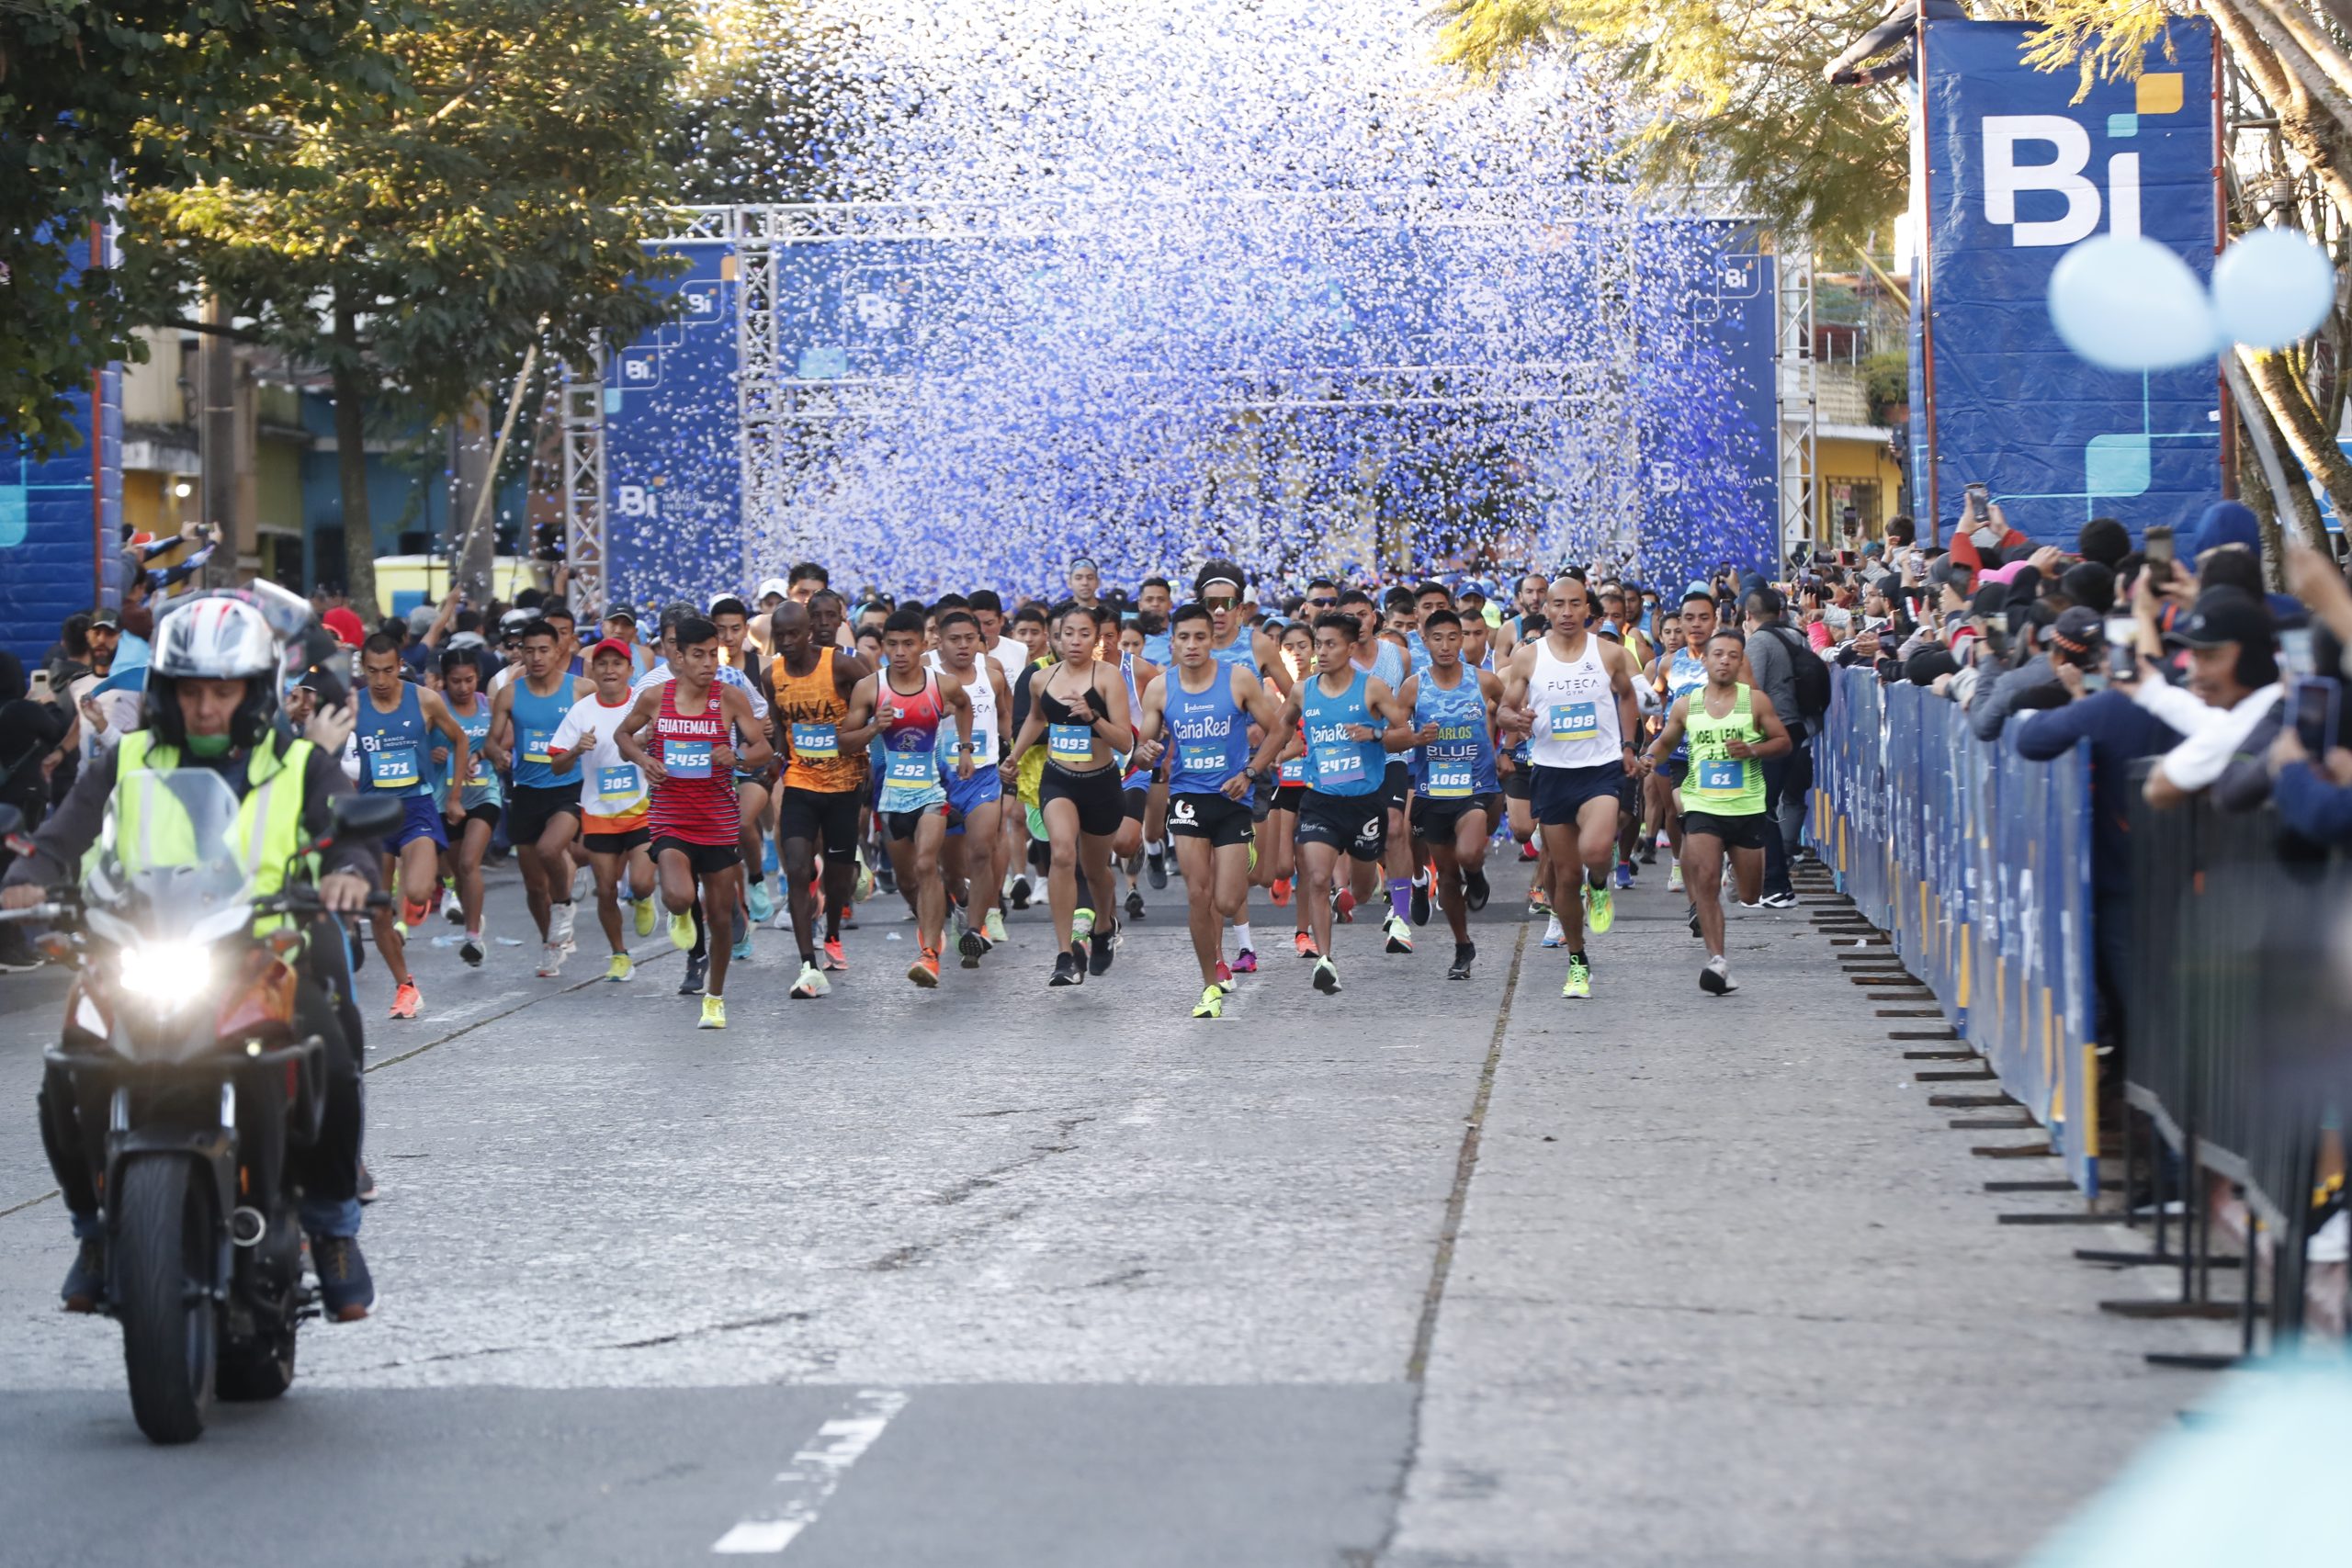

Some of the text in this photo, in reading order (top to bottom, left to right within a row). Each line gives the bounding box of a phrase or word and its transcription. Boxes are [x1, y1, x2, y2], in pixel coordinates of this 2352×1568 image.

[1982, 113, 2142, 247] Bi
[626, 359, 650, 379] Bi
[618, 485, 657, 517] Bi
[1548, 678, 1600, 691] FUTECA
[1305, 708, 1320, 716] GUA
[658, 718, 718, 734] GUATEMALA
[1553, 715, 1595, 729] 1098
[1437, 726, 1473, 740] ARLOS
[361, 735, 381, 752] Bi
[795, 735, 835, 748] 1095
[1051, 738, 1090, 750] 1093
[1426, 744, 1478, 757] BLUE
[664, 752, 711, 767] 2455
[1183, 755, 1226, 770] 1092
[1319, 755, 1361, 773] 2473
[378, 761, 411, 776] 271
[892, 763, 926, 777] 292
[604, 776, 633, 790] 305
[1430, 773, 1471, 785] 1068
[1710, 773, 1732, 785] 61
